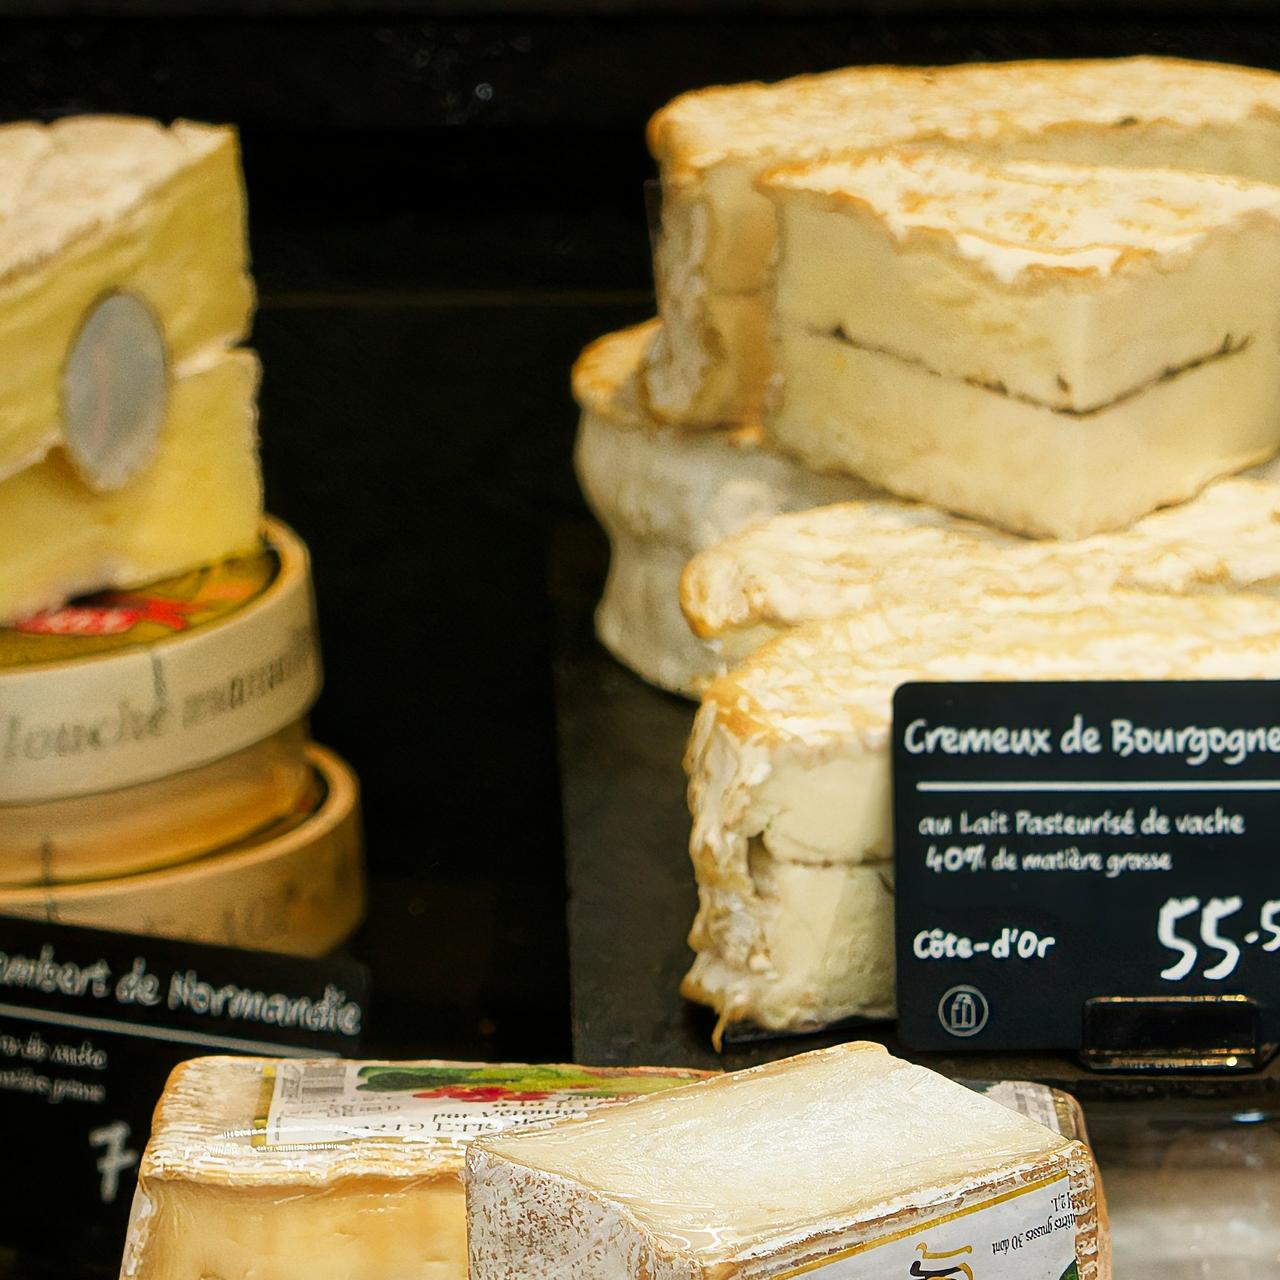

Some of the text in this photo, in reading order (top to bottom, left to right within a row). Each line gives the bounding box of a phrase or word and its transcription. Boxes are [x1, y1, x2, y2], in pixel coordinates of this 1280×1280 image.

[904, 717, 1052, 756] Cremeux
[1060, 714, 1101, 753] de
[919, 808, 1244, 835] au Lait Pasteurisé de vache
[926, 847, 1172, 877] 40% de matière grasse
[913, 927, 1055, 960] Côte-d'Or
[0, 944, 361, 1035] mbert de Normandie
